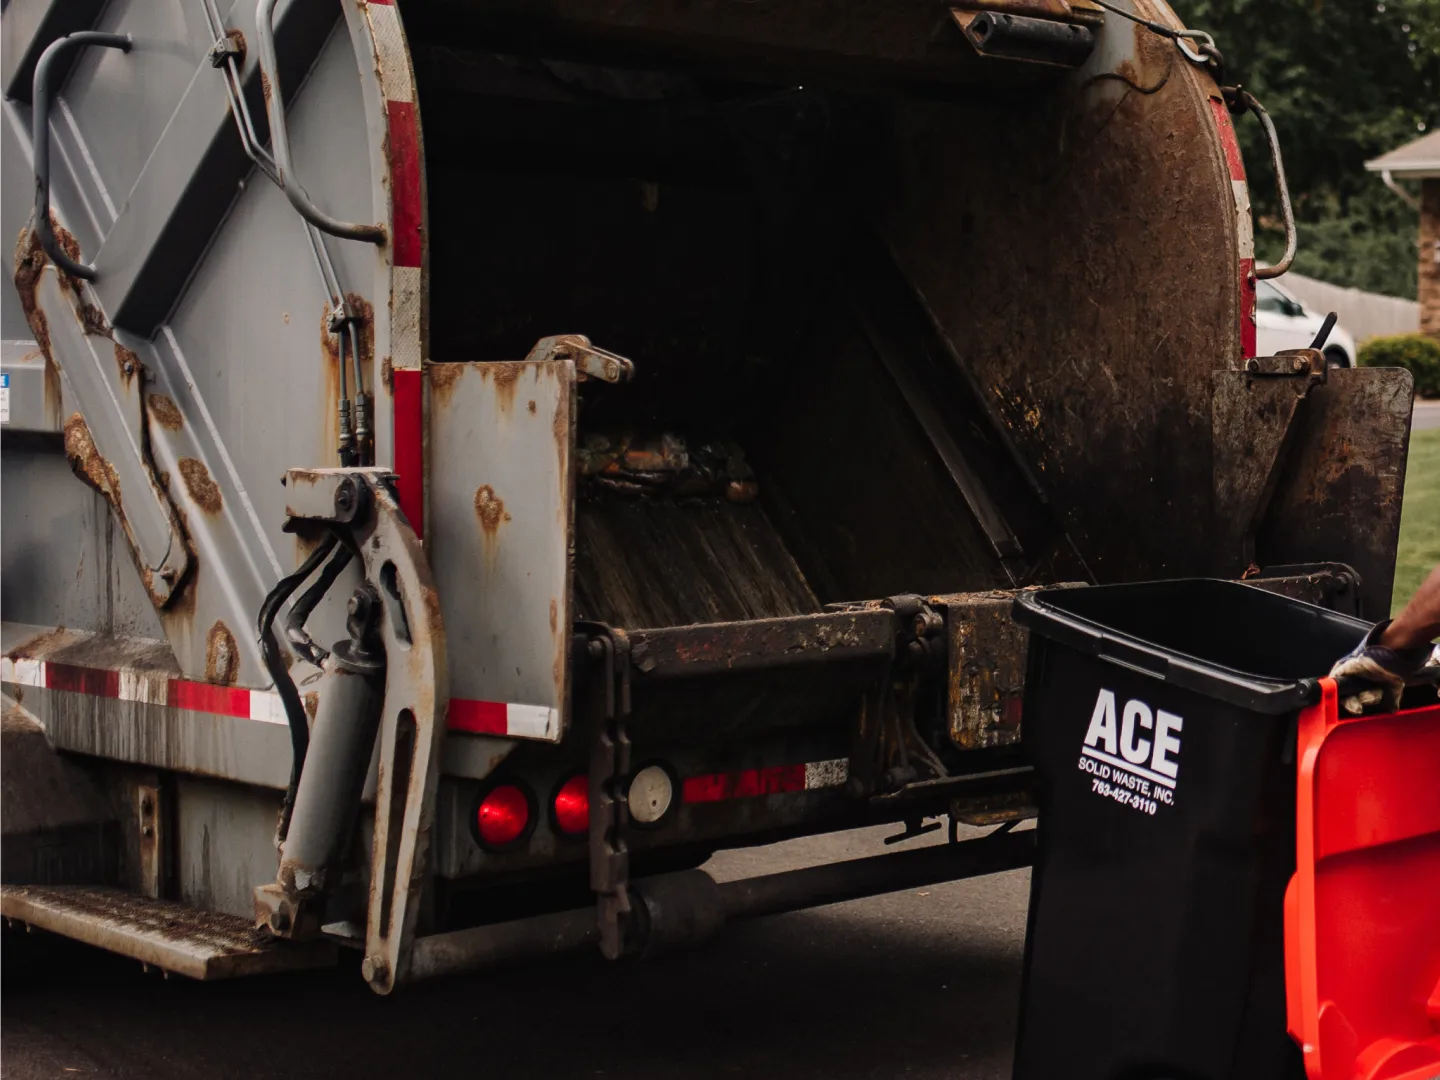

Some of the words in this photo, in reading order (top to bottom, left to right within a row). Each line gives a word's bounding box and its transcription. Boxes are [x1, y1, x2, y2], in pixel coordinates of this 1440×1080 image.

[1083, 688, 1183, 779] ACE
[1078, 757, 1110, 779] SOLID
[1112, 769, 1151, 798] WASTE,
[1091, 778, 1157, 815] 763-427-3110
